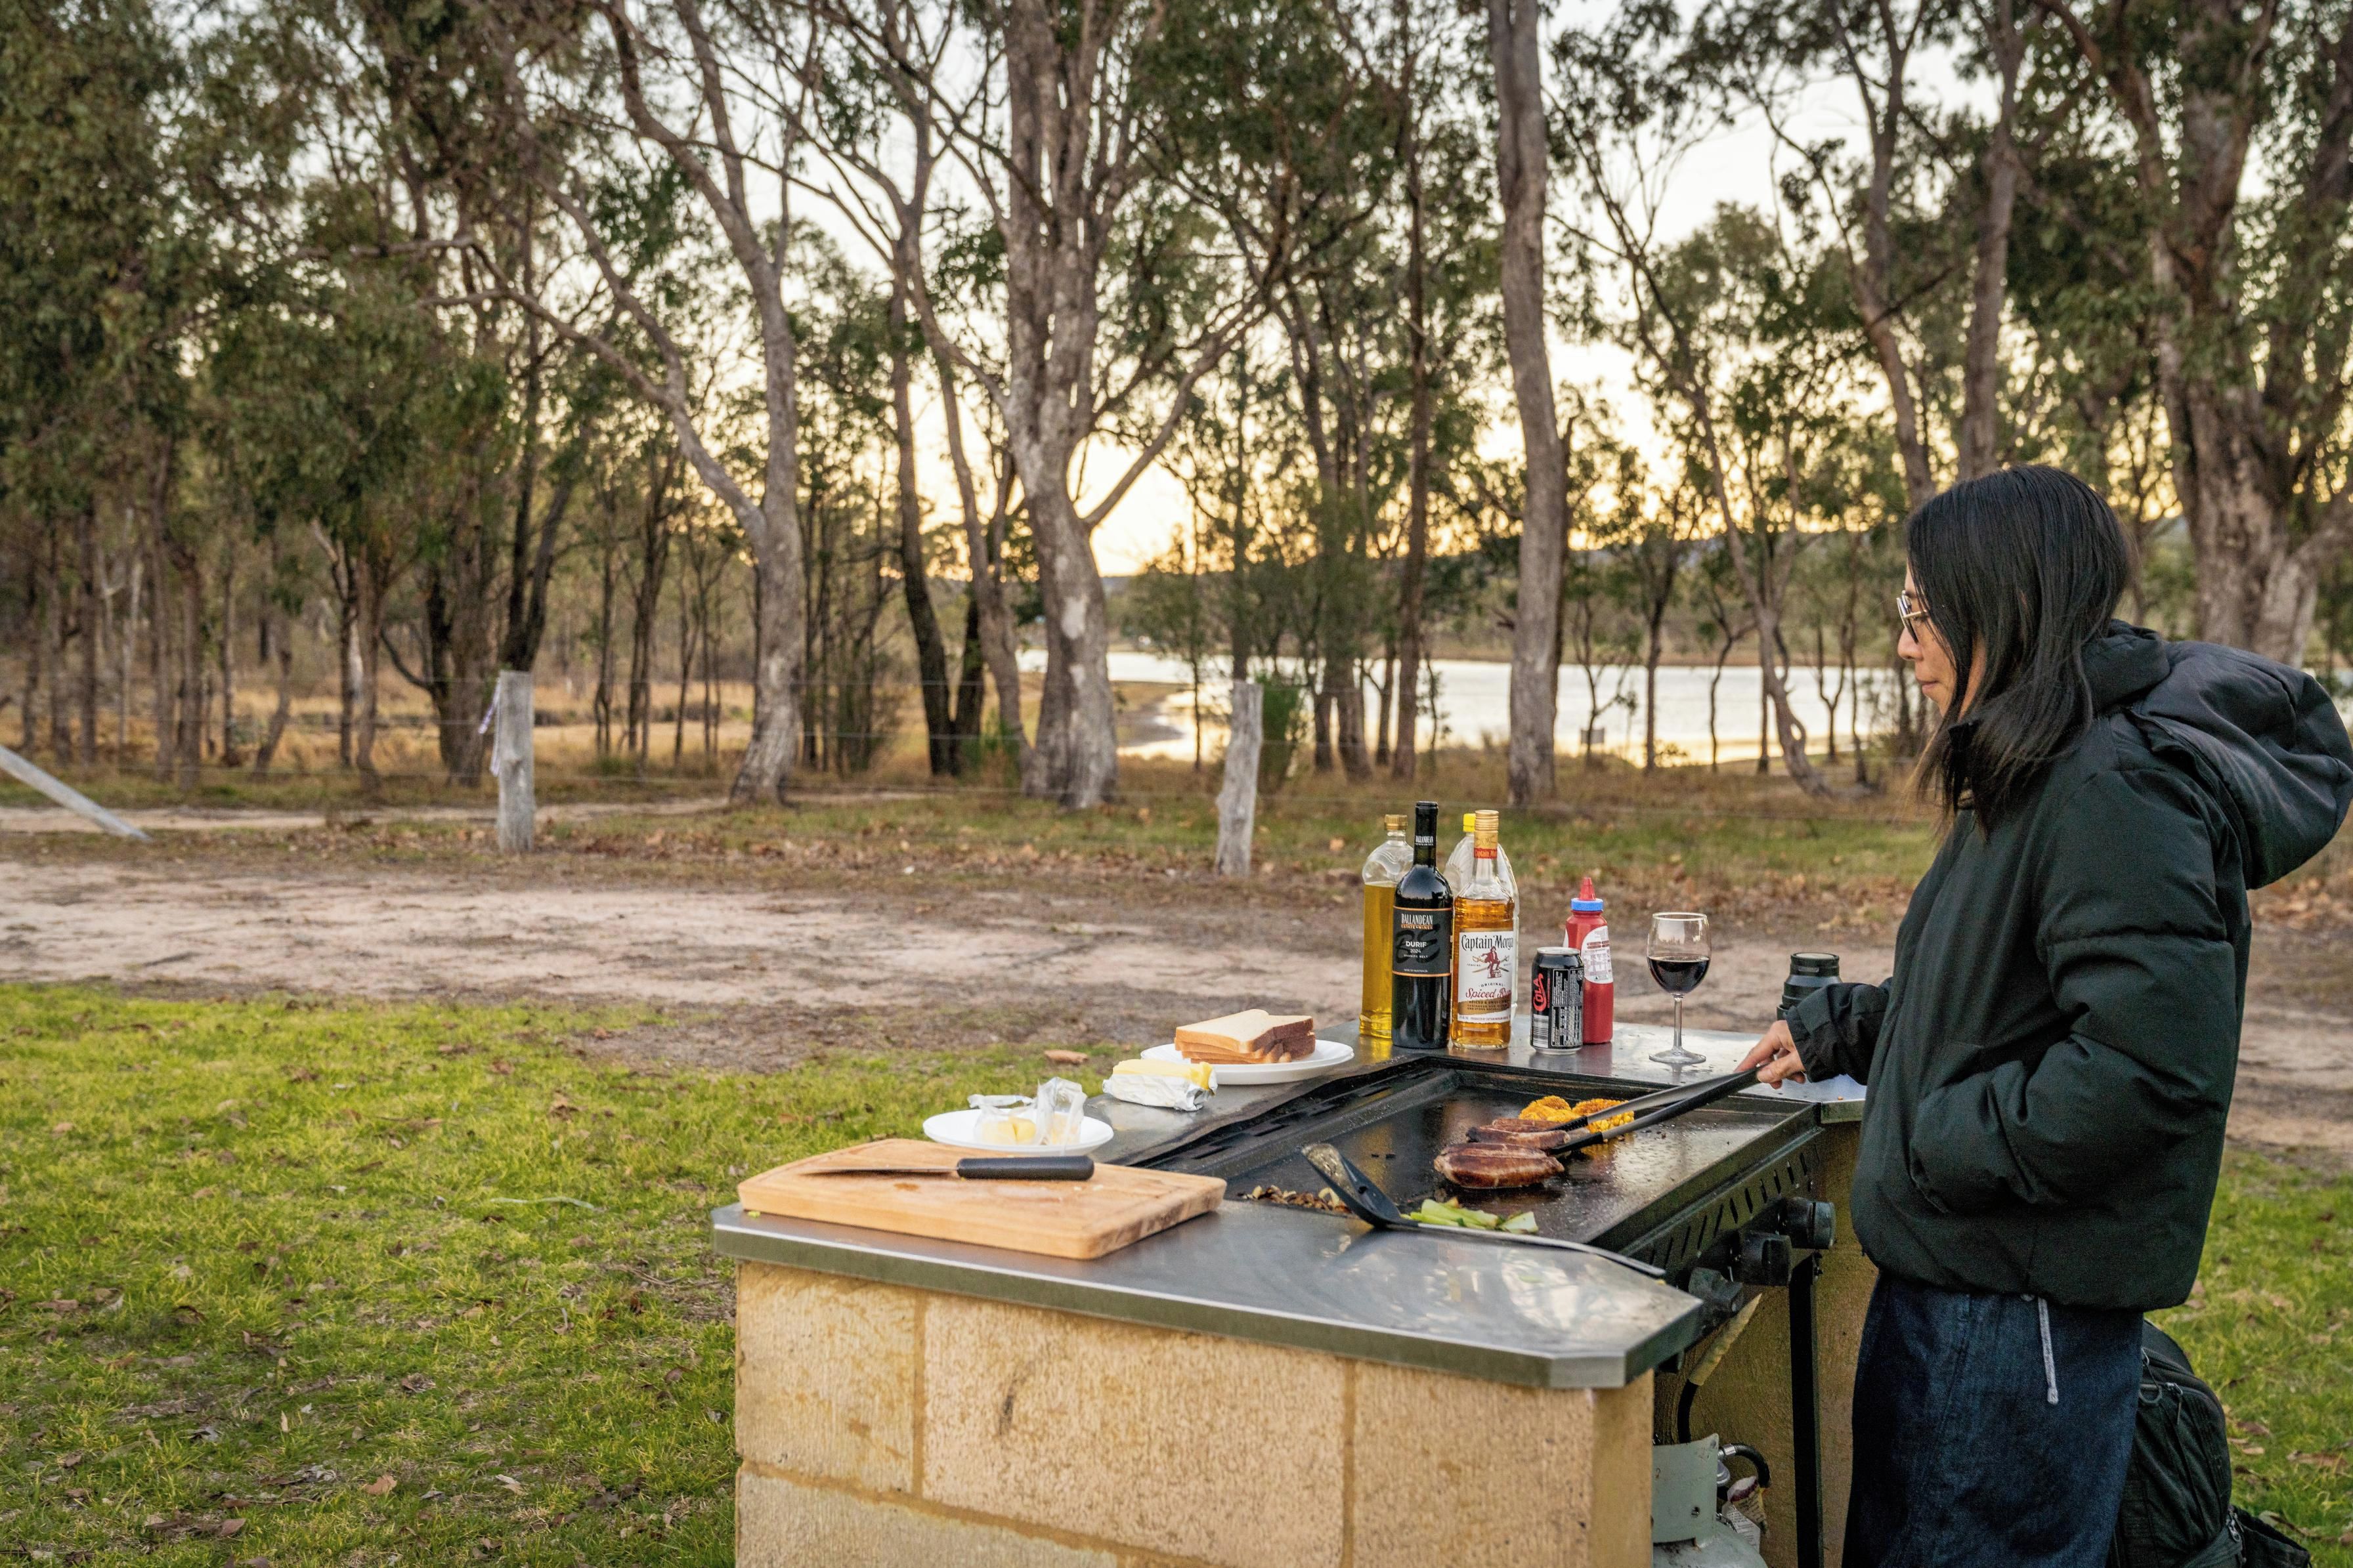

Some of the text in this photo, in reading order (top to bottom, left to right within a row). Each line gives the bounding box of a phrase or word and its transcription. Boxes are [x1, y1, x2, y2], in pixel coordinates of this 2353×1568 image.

[1401, 913, 1433, 925] BALLANDEAN
[1461, 935, 1514, 951] Captain Morga
[1465, 988, 1496, 999] Spiced
[1533, 973, 1547, 1012] COLA
